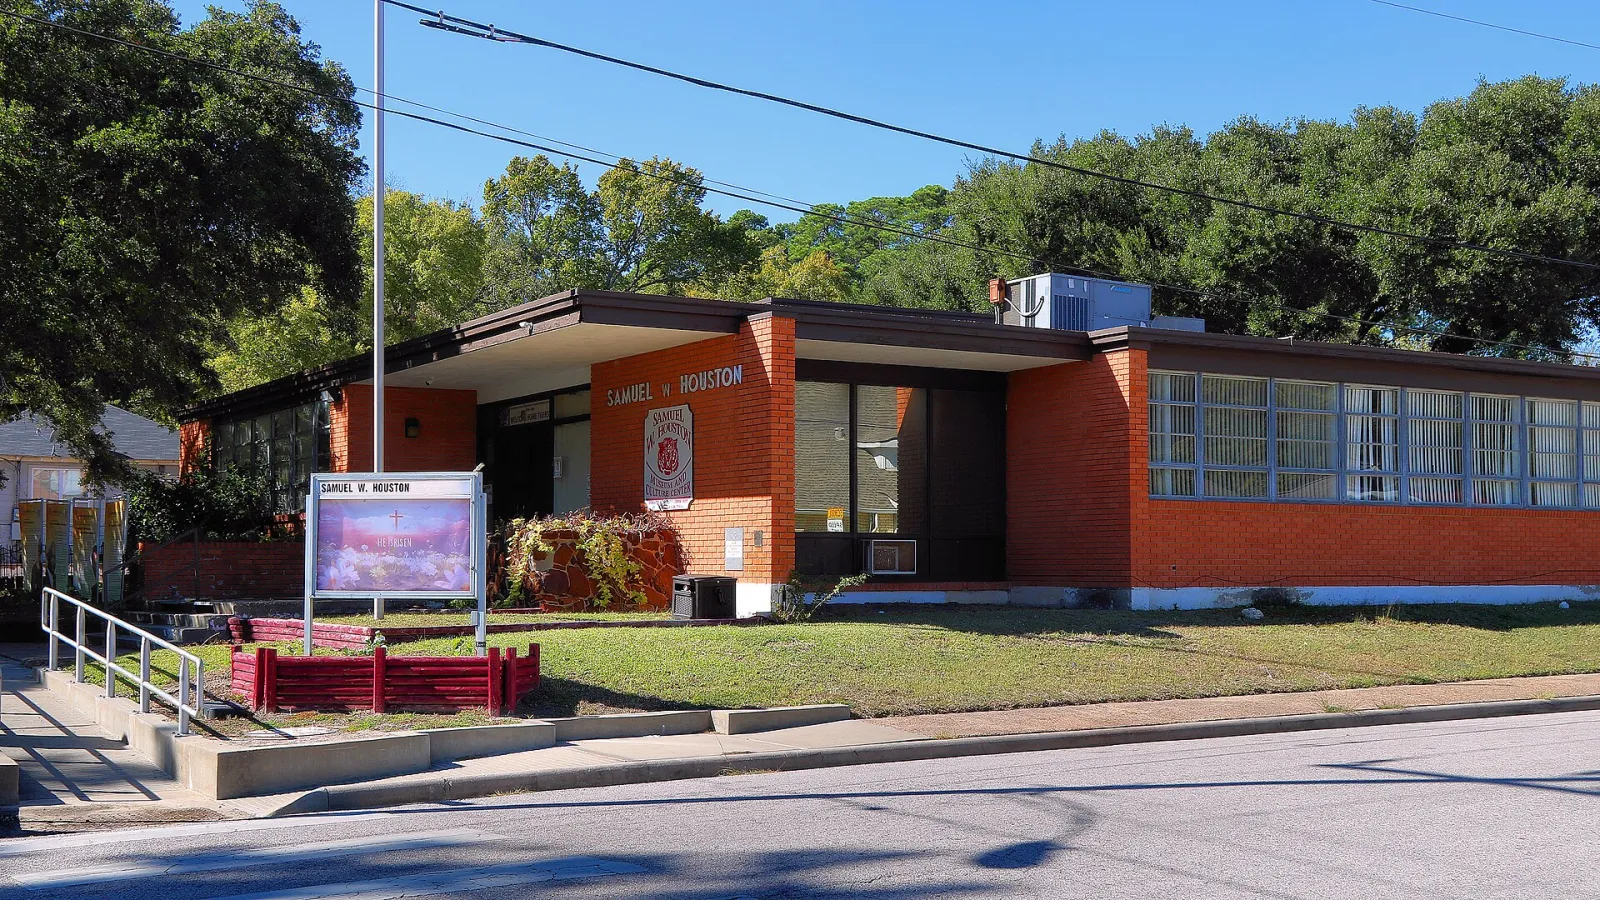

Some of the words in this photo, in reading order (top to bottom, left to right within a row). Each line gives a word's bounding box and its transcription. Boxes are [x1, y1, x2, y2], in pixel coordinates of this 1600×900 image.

[607, 382, 653, 407] SAMUEL
[662, 383, 671, 397] W
[680, 364, 742, 394] HOUSTON
[653, 408, 684, 426] SAMUEL
[658, 422, 692, 450] HOUSTON
[321, 482, 353, 493] SAMUEL
[357, 482, 368, 493] W.
[372, 482, 410, 493] HOUSTON
[650, 473, 674, 488] MUSEUM
[674, 471, 687, 486] AND
[645, 483, 669, 497] CULTURE
[670, 481, 691, 497] CENTER
[377, 537, 386, 548] HE
[393, 537, 412, 548] RISEN
